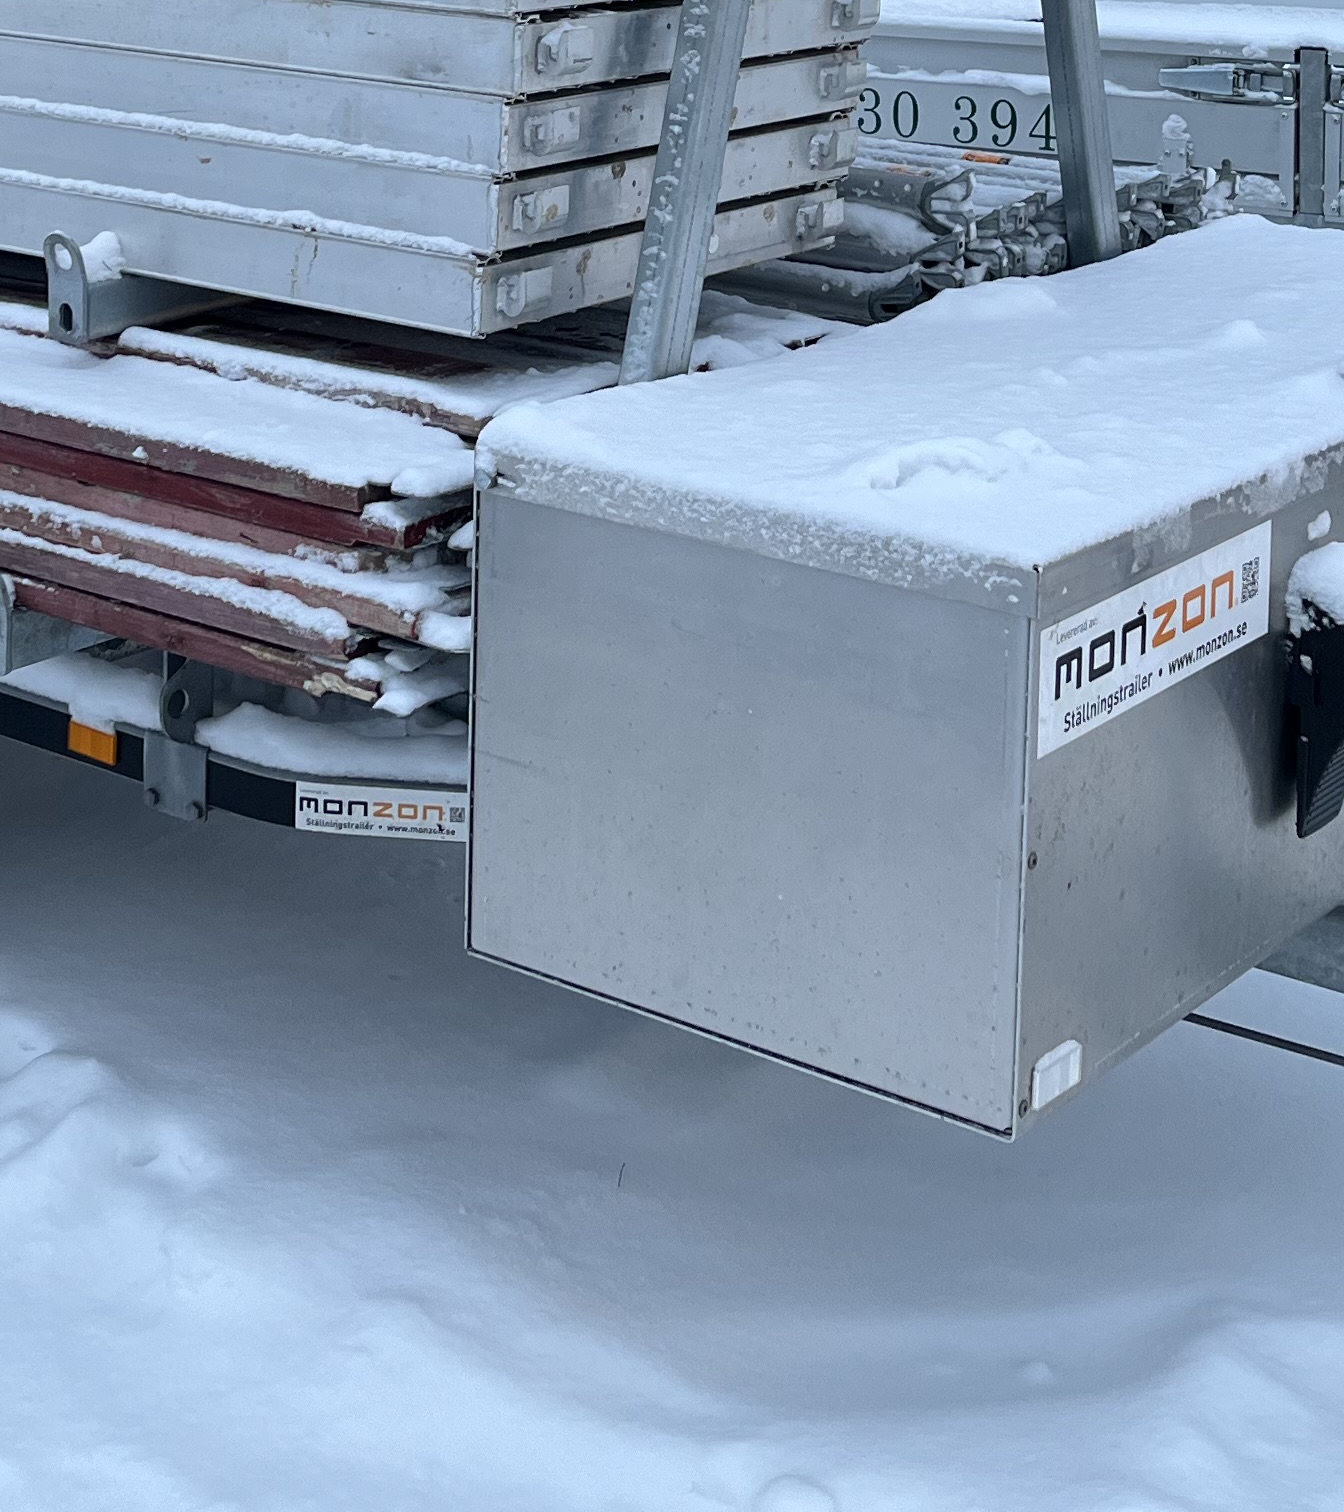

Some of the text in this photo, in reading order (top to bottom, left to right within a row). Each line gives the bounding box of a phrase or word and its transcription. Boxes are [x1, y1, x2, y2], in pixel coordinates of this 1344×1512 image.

[857, 88, 919, 138] 30
[1055, 570, 1234, 701] monzon
[1064, 621, 1248, 733] Ställningstrailer www.monzon.se
[299, 796, 444, 821] monzon
[306, 817, 374, 831] Ställningstrailer
